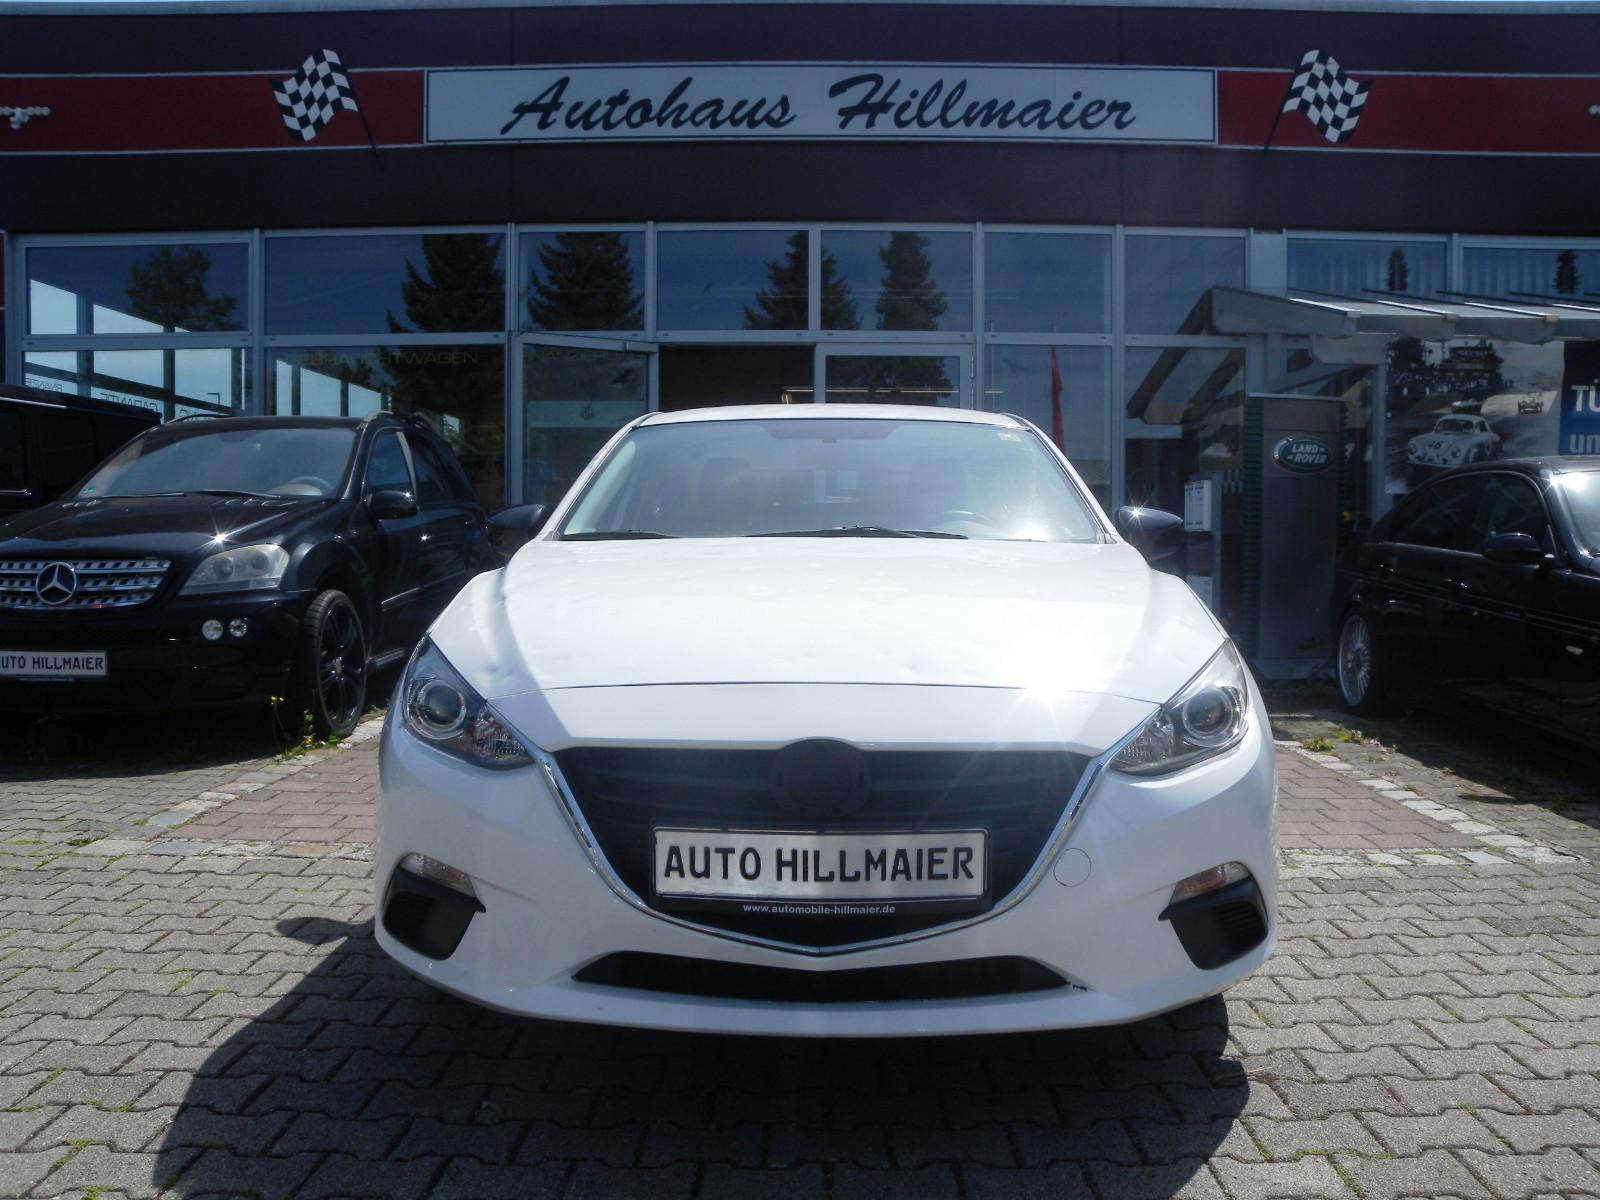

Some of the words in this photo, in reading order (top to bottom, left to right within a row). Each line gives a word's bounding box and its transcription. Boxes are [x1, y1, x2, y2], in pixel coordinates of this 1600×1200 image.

[500, 75, 796, 136] Autohaus
[829, 72, 1136, 132] Hillmaier
[1292, 443, 1319, 454] LAND
[1293, 453, 1328, 464] ROVER
[0, 655, 26, 669] UTO
[32, 656, 104, 671] HILLMAIER
[664, 845, 762, 881] AUTO
[775, 846, 974, 882] HILLMAIER
[743, 903, 896, 915] www.automobile-hillmaier.de
